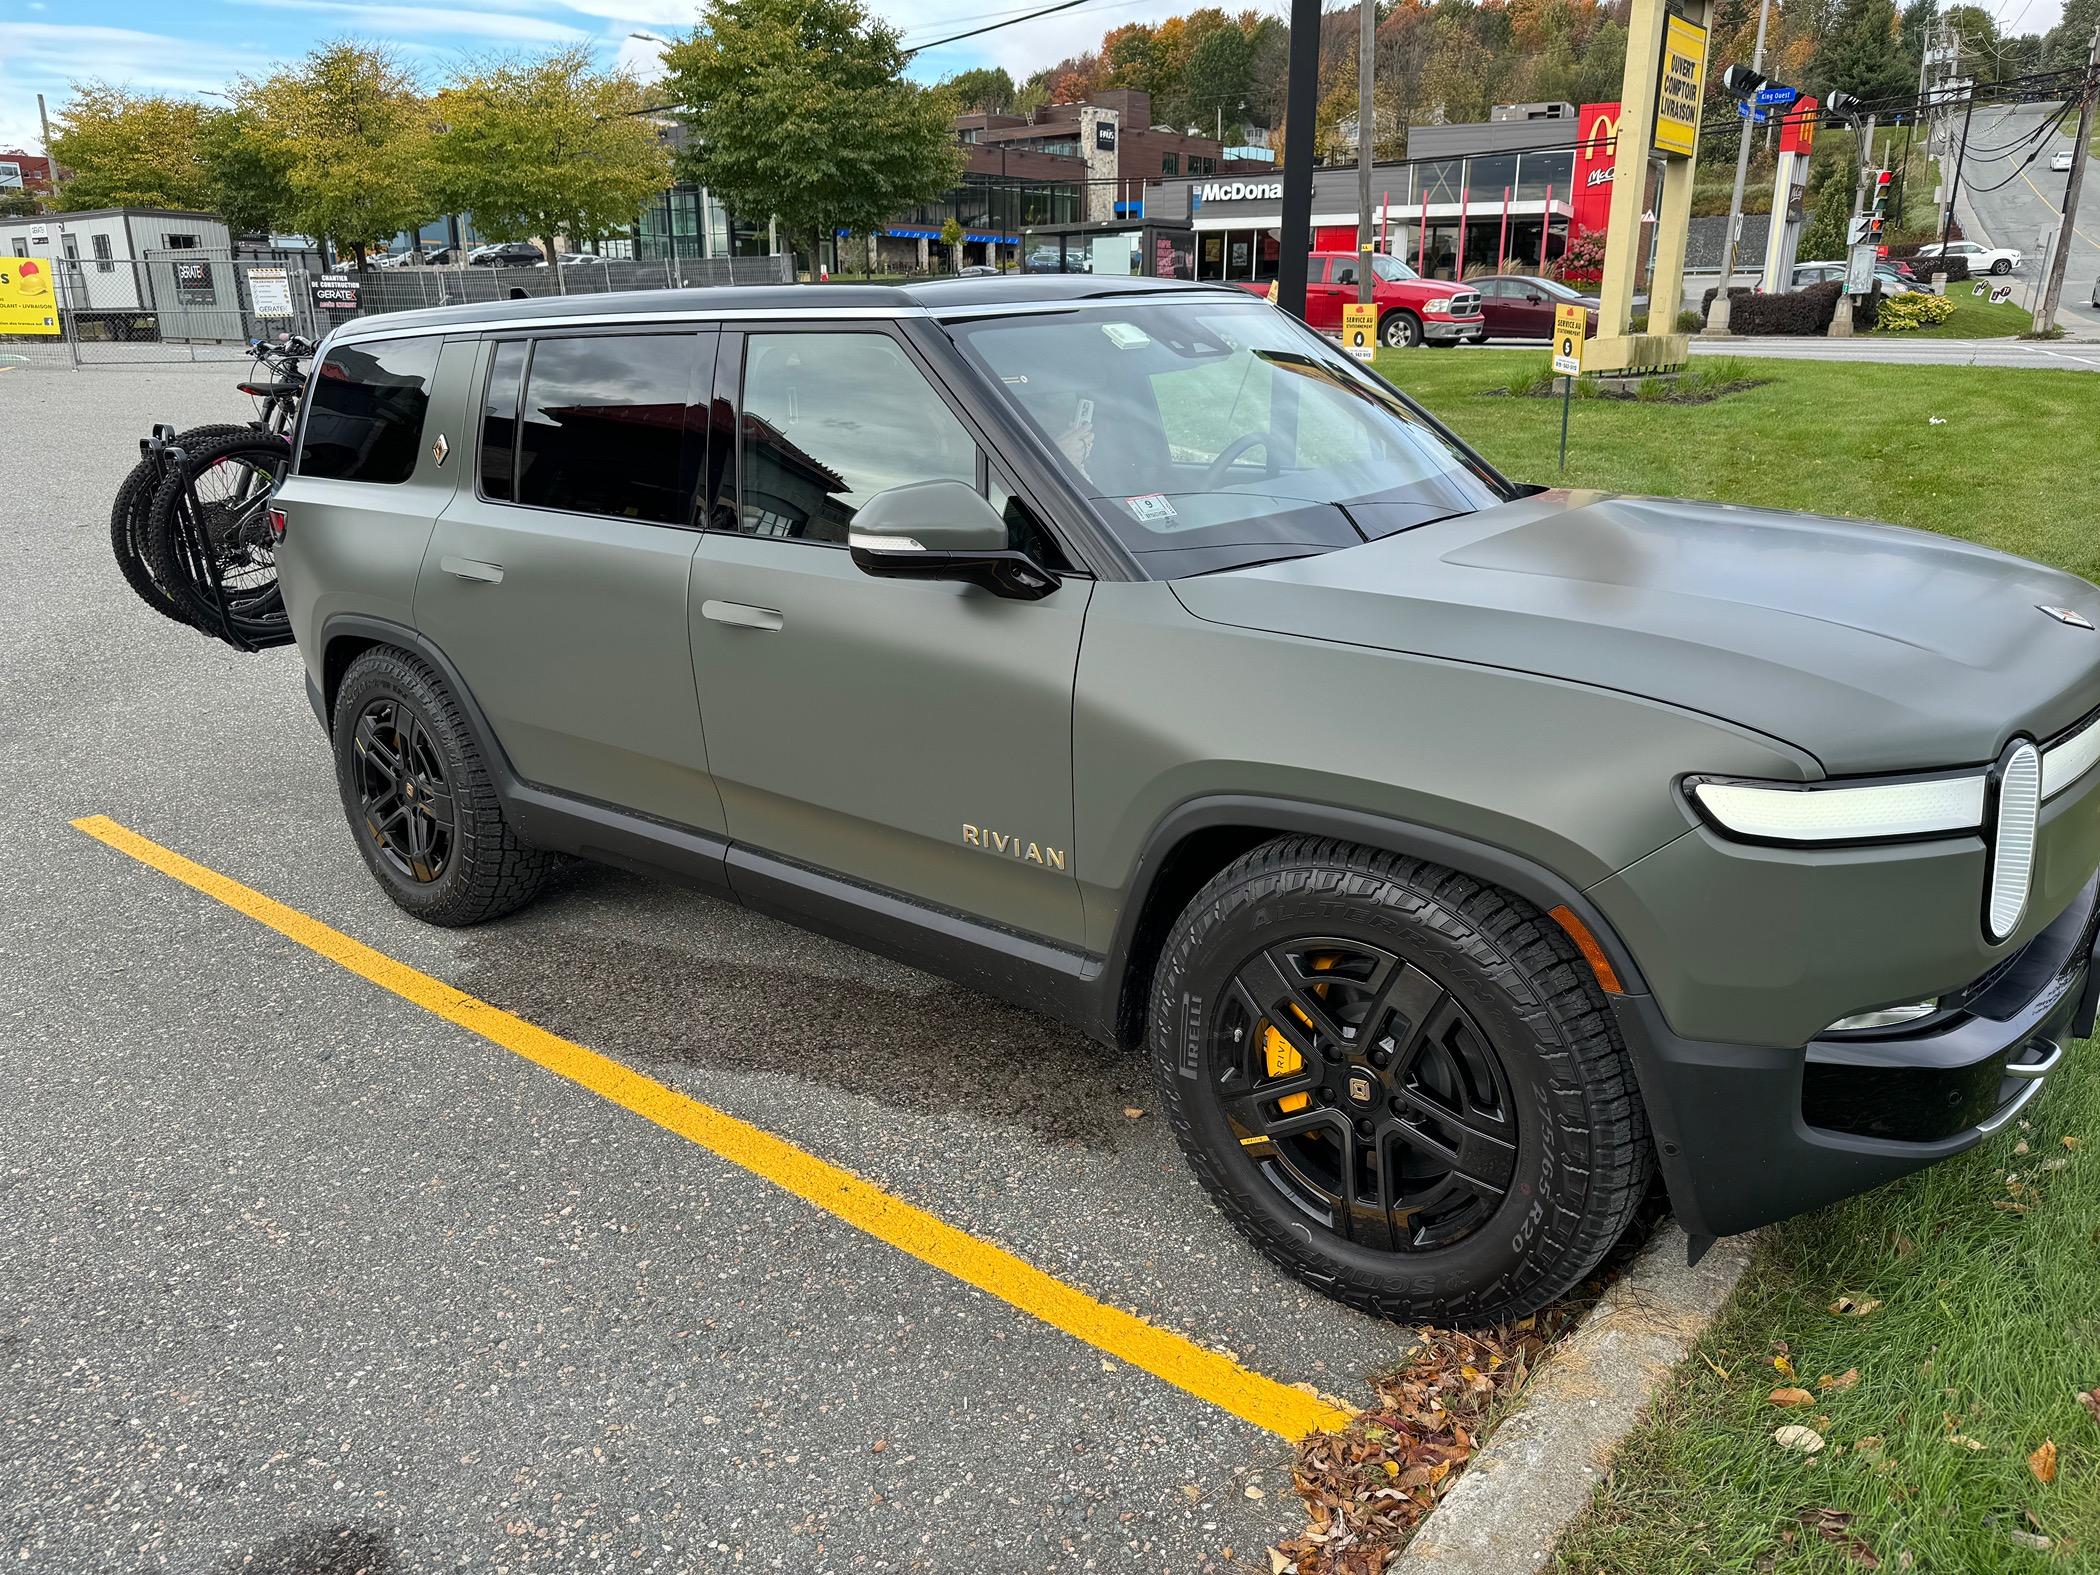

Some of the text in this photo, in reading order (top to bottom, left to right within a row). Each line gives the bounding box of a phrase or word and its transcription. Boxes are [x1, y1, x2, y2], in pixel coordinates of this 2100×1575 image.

[1671, 54, 1696, 79] OUVERT
[1664, 77, 1697, 101] COMPTOIR
[1762, 91, 1791, 101] King Ouest
[1587, 167, 1614, 187] McC
[316, 290, 357, 300] GERATEK
[1346, 316, 1373, 324] SERVICE AU
[1557, 320, 1582, 330] SERVICE AU
[962, 823, 1066, 871] RIVIAN
[1178, 991, 1203, 1081] PIRELLI
[1276, 1039, 1287, 1070] RIVI
[1511, 1199, 1545, 1255] R20
